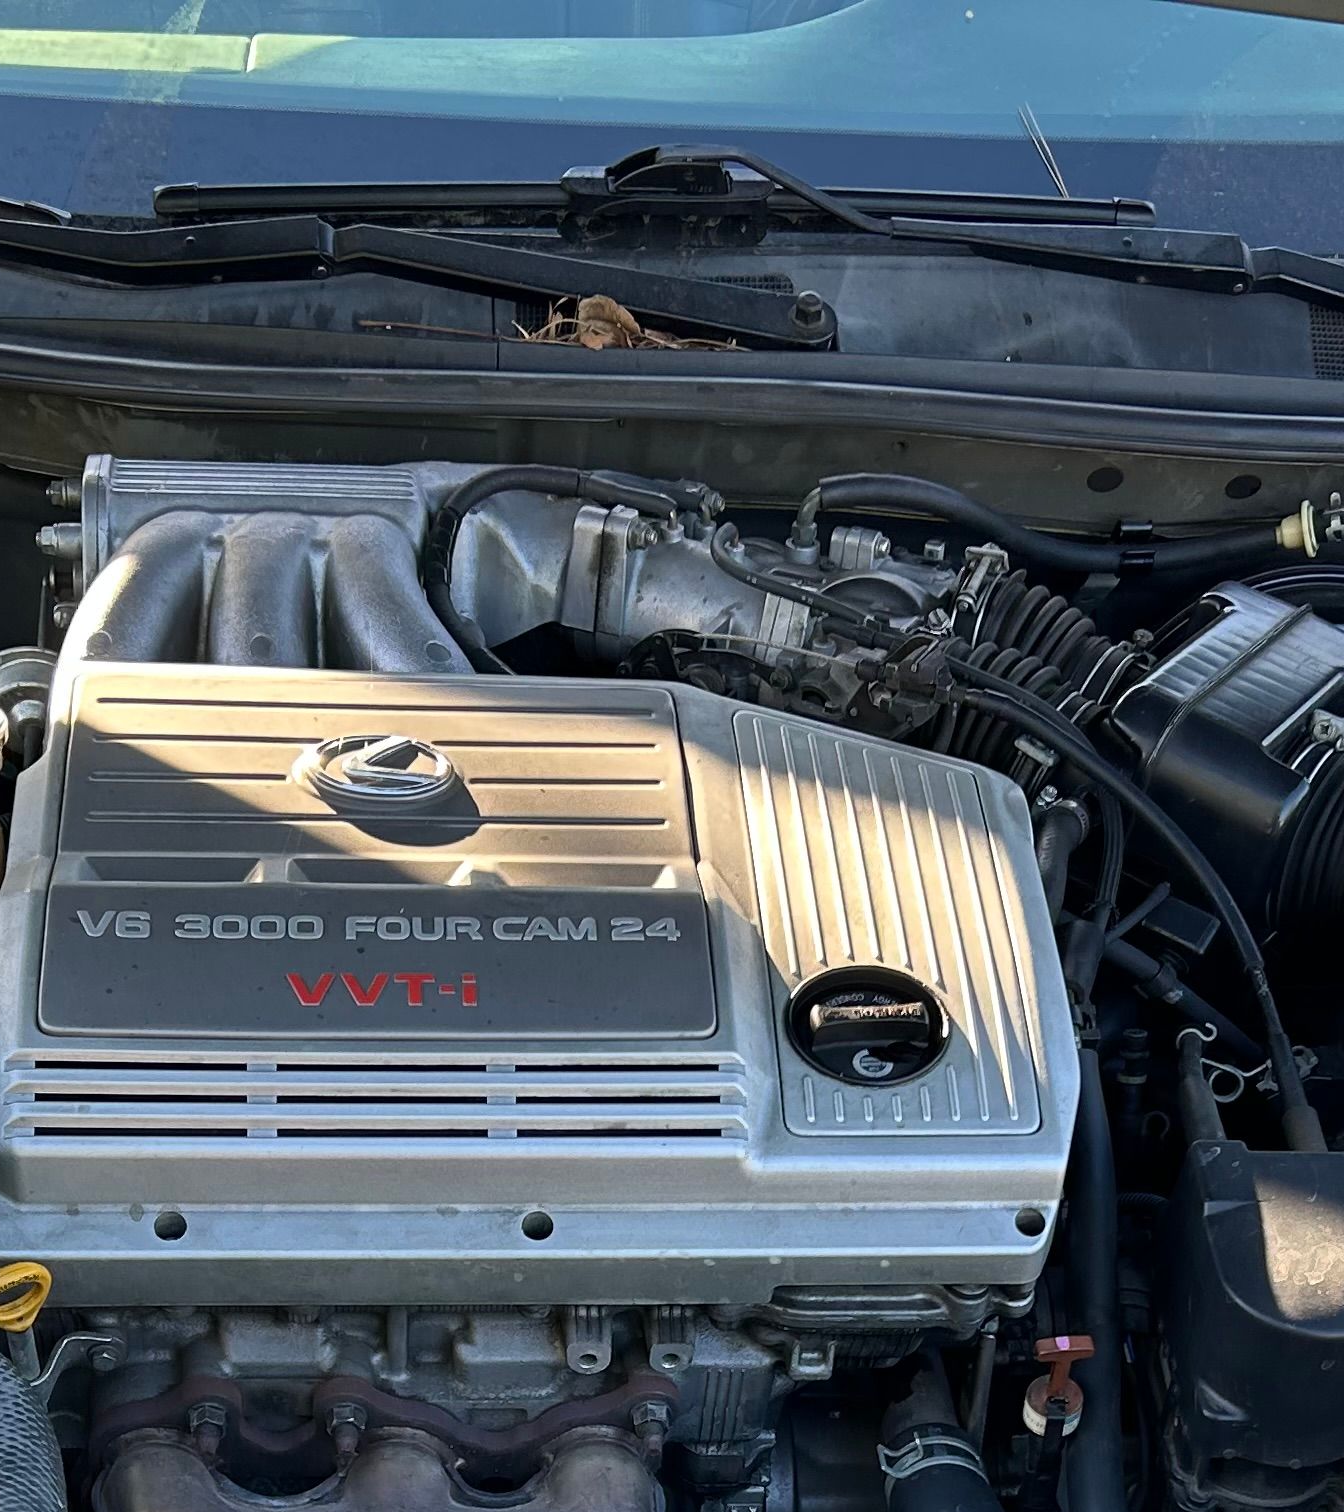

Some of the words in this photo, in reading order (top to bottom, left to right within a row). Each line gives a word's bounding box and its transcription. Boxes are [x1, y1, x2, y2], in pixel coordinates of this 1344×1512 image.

[76, 909, 151, 939] V6
[174, 913, 323, 940] 3000
[344, 914, 484, 941] FOUR
[492, 915, 598, 942] CAM
[611, 916, 681, 942] 24
[286, 972, 479, 1007] VVT-i
